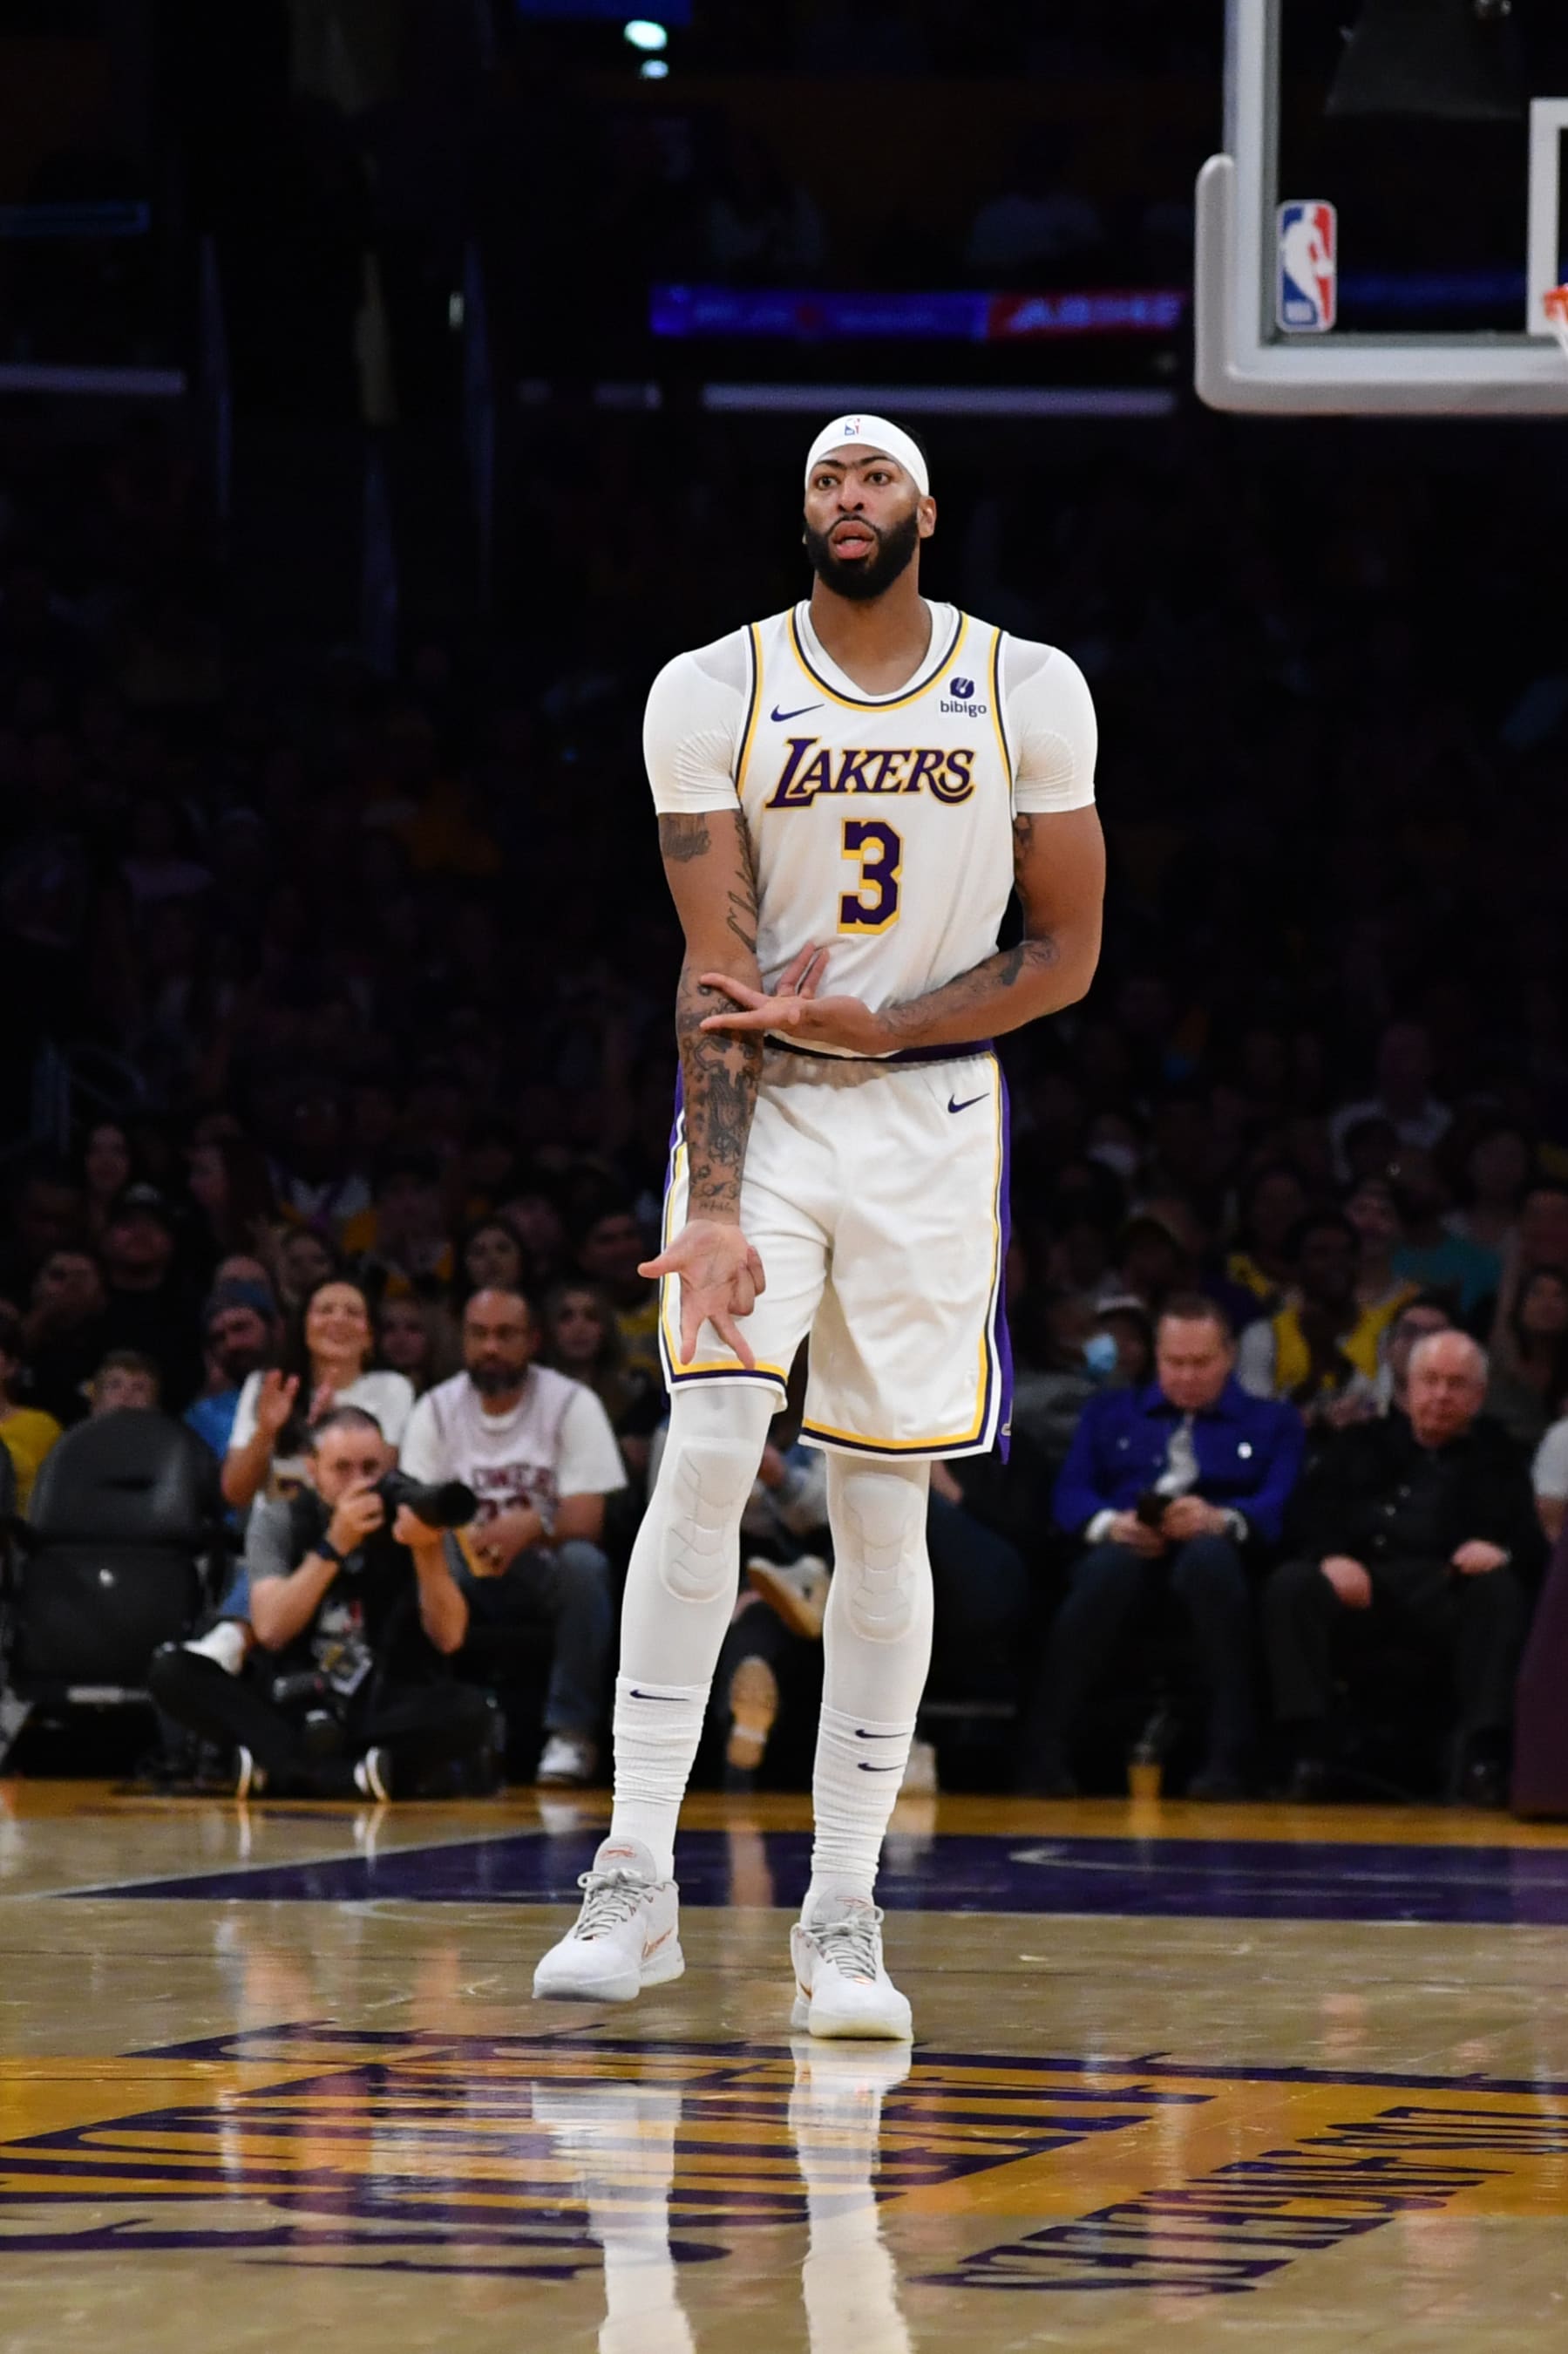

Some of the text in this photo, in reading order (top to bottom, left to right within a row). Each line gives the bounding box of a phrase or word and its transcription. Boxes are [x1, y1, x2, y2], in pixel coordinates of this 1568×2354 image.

[940, 700, 987, 718] bibigo
[764, 736, 977, 808] LAKERS
[837, 817, 904, 935] 3
[906, 2148, 1515, 2294] ANGELES
